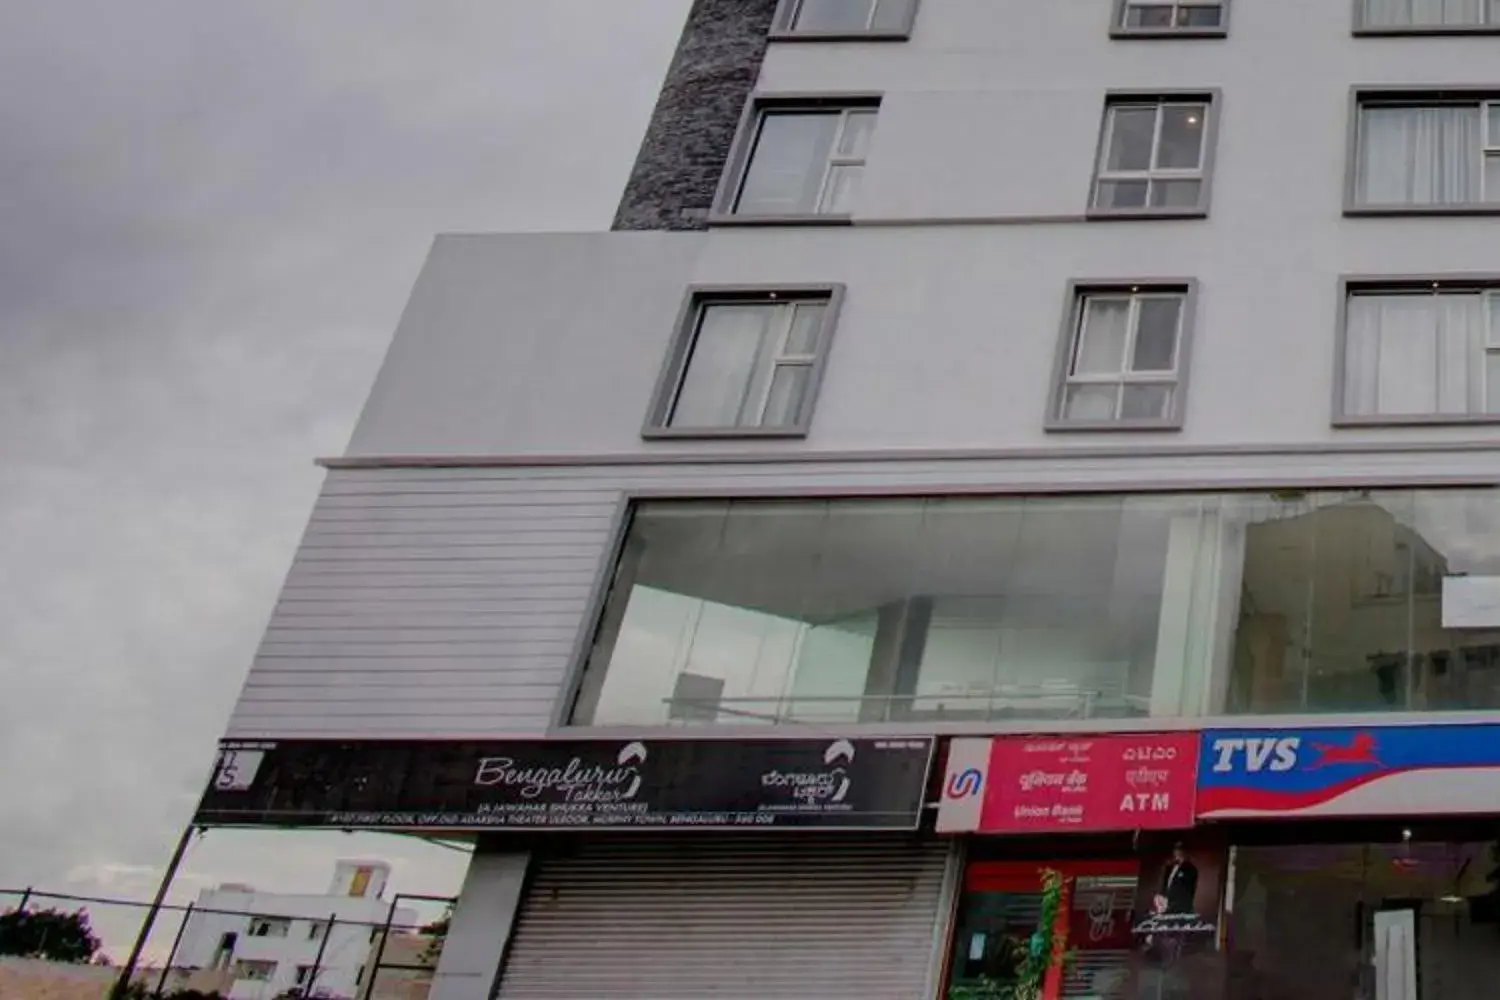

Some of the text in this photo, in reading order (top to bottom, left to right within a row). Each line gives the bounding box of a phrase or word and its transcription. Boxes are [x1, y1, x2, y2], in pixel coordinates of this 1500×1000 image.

[1212, 738, 1300, 772] TVS
[475, 757, 630, 798] Bengaluru
[1120, 793, 1170, 812] ATM
